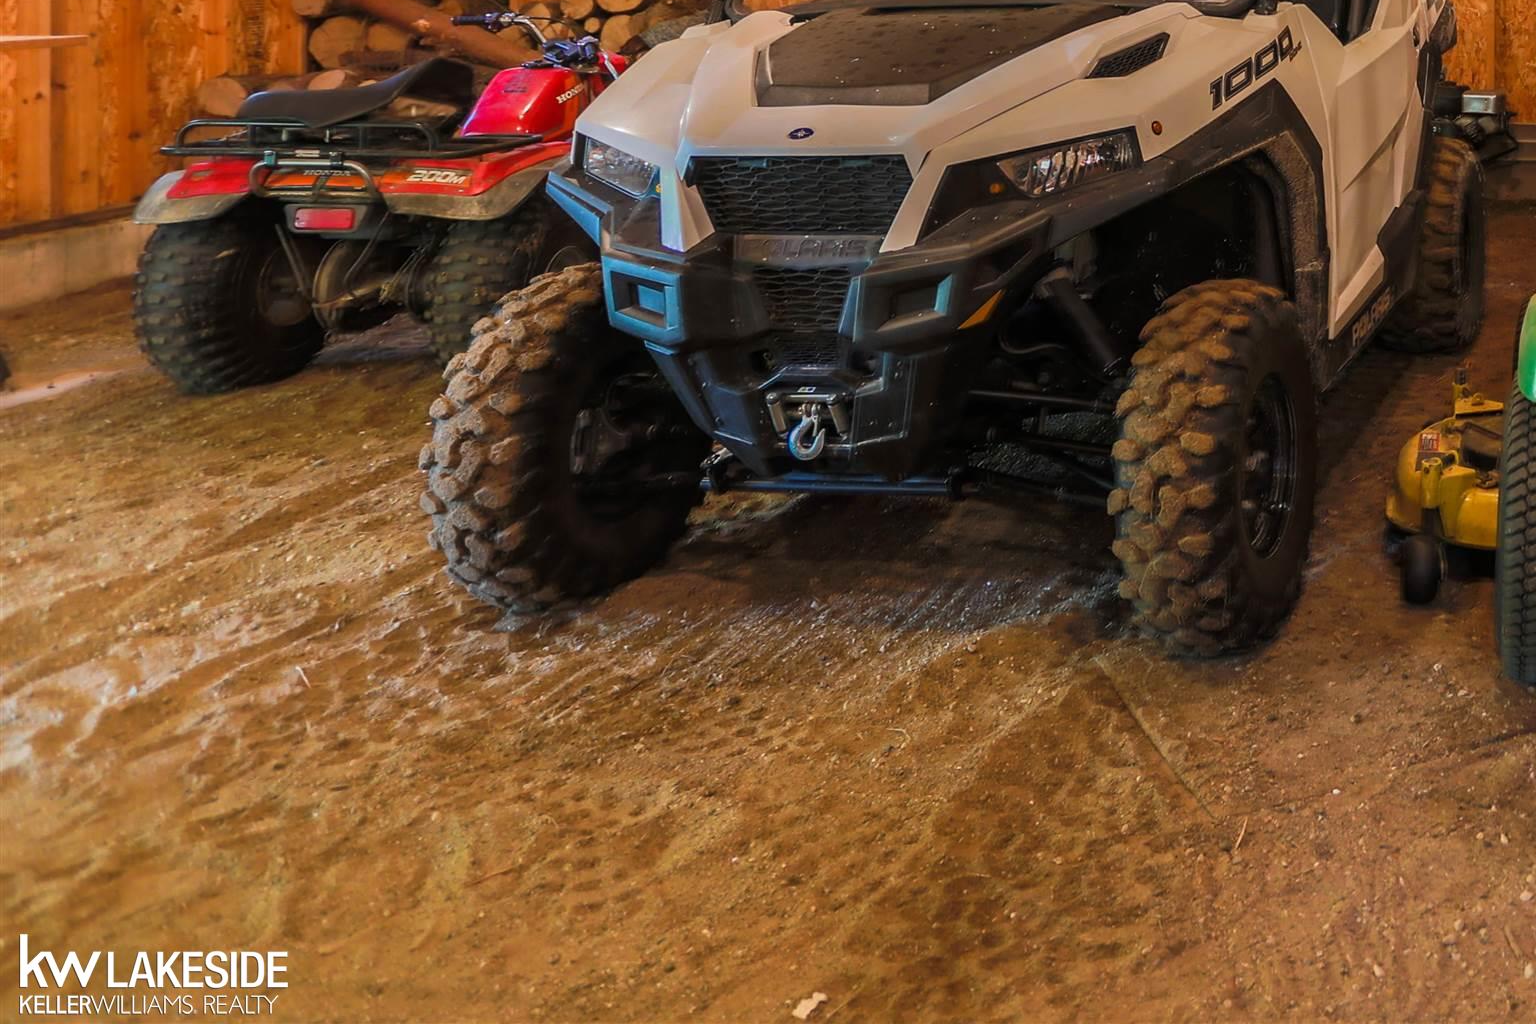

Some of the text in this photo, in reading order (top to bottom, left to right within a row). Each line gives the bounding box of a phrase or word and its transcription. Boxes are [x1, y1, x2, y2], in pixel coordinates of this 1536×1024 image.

[1209, 25, 1293, 111] 1000
[303, 169, 351, 177] HONDA
[406, 169, 468, 185] 200M
